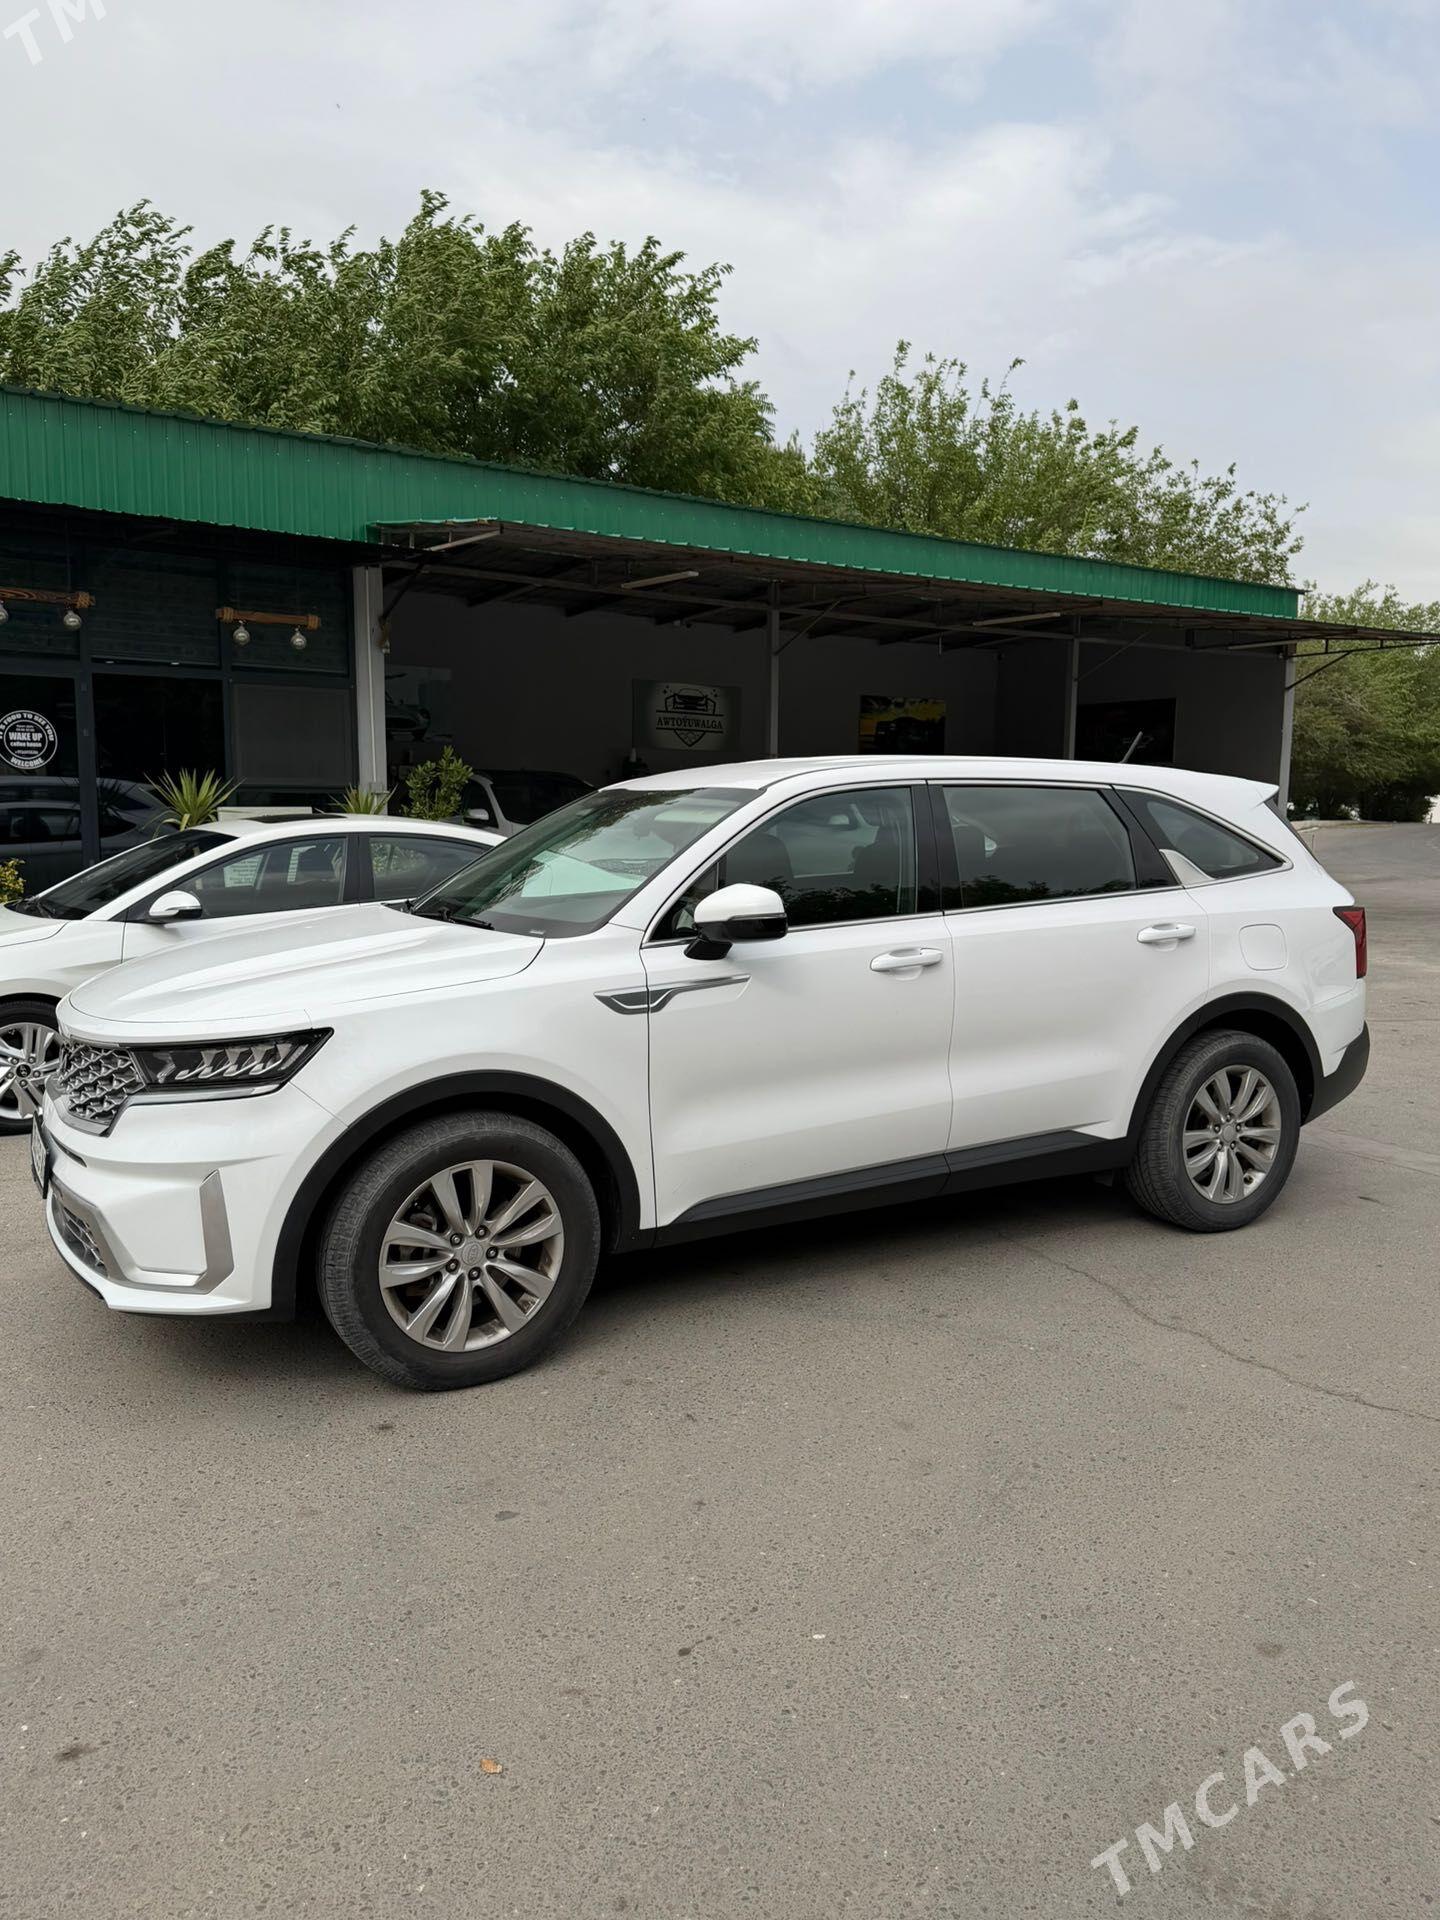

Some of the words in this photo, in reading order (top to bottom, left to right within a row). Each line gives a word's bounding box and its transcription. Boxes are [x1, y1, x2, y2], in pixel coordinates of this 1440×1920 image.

[33, 715, 47, 726] SEE
[45, 724, 54, 741] YOU
[8, 732, 31, 741] WAKE
[32, 732, 43, 741] UP
[11, 756, 44, 767] WELCOME
